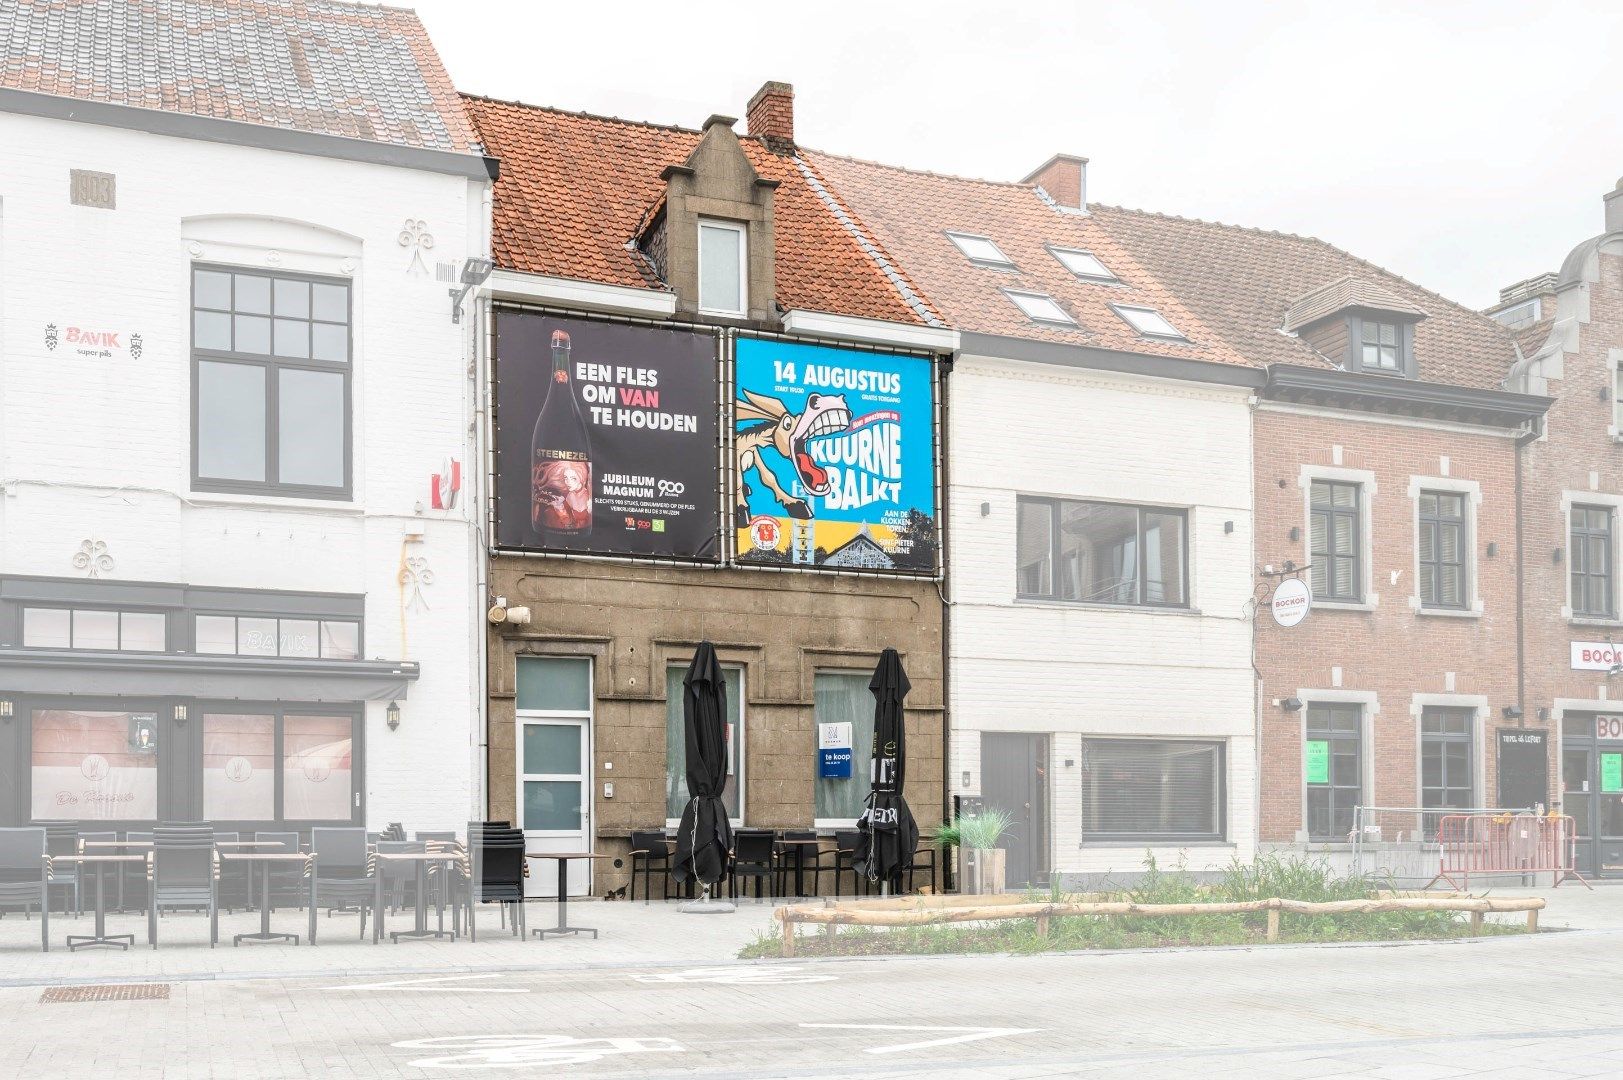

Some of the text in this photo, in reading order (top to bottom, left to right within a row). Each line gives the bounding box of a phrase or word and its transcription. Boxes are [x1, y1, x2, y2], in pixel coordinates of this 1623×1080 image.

[74, 174, 110, 203] 1903
[66, 327, 121, 348] BAVIK
[99, 349, 112, 358] pils
[576, 362, 658, 387] EEN FLES
[774, 361, 901, 394] 14 AUGUSTUS
[583, 385, 659, 408] OM VAN
[591, 406, 697, 432] TE HOUDEN
[536, 448, 588, 460] STEENEZEL
[811, 423, 901, 479] KUURNE
[602, 474, 654, 486] JUBILEUM
[658, 480, 685, 497] 900
[825, 466, 901, 510] BALKT
[603, 485, 654, 498] MAGNUM
[1275, 597, 1305, 607] BOCKOR
[833, 753, 851, 762] koop
